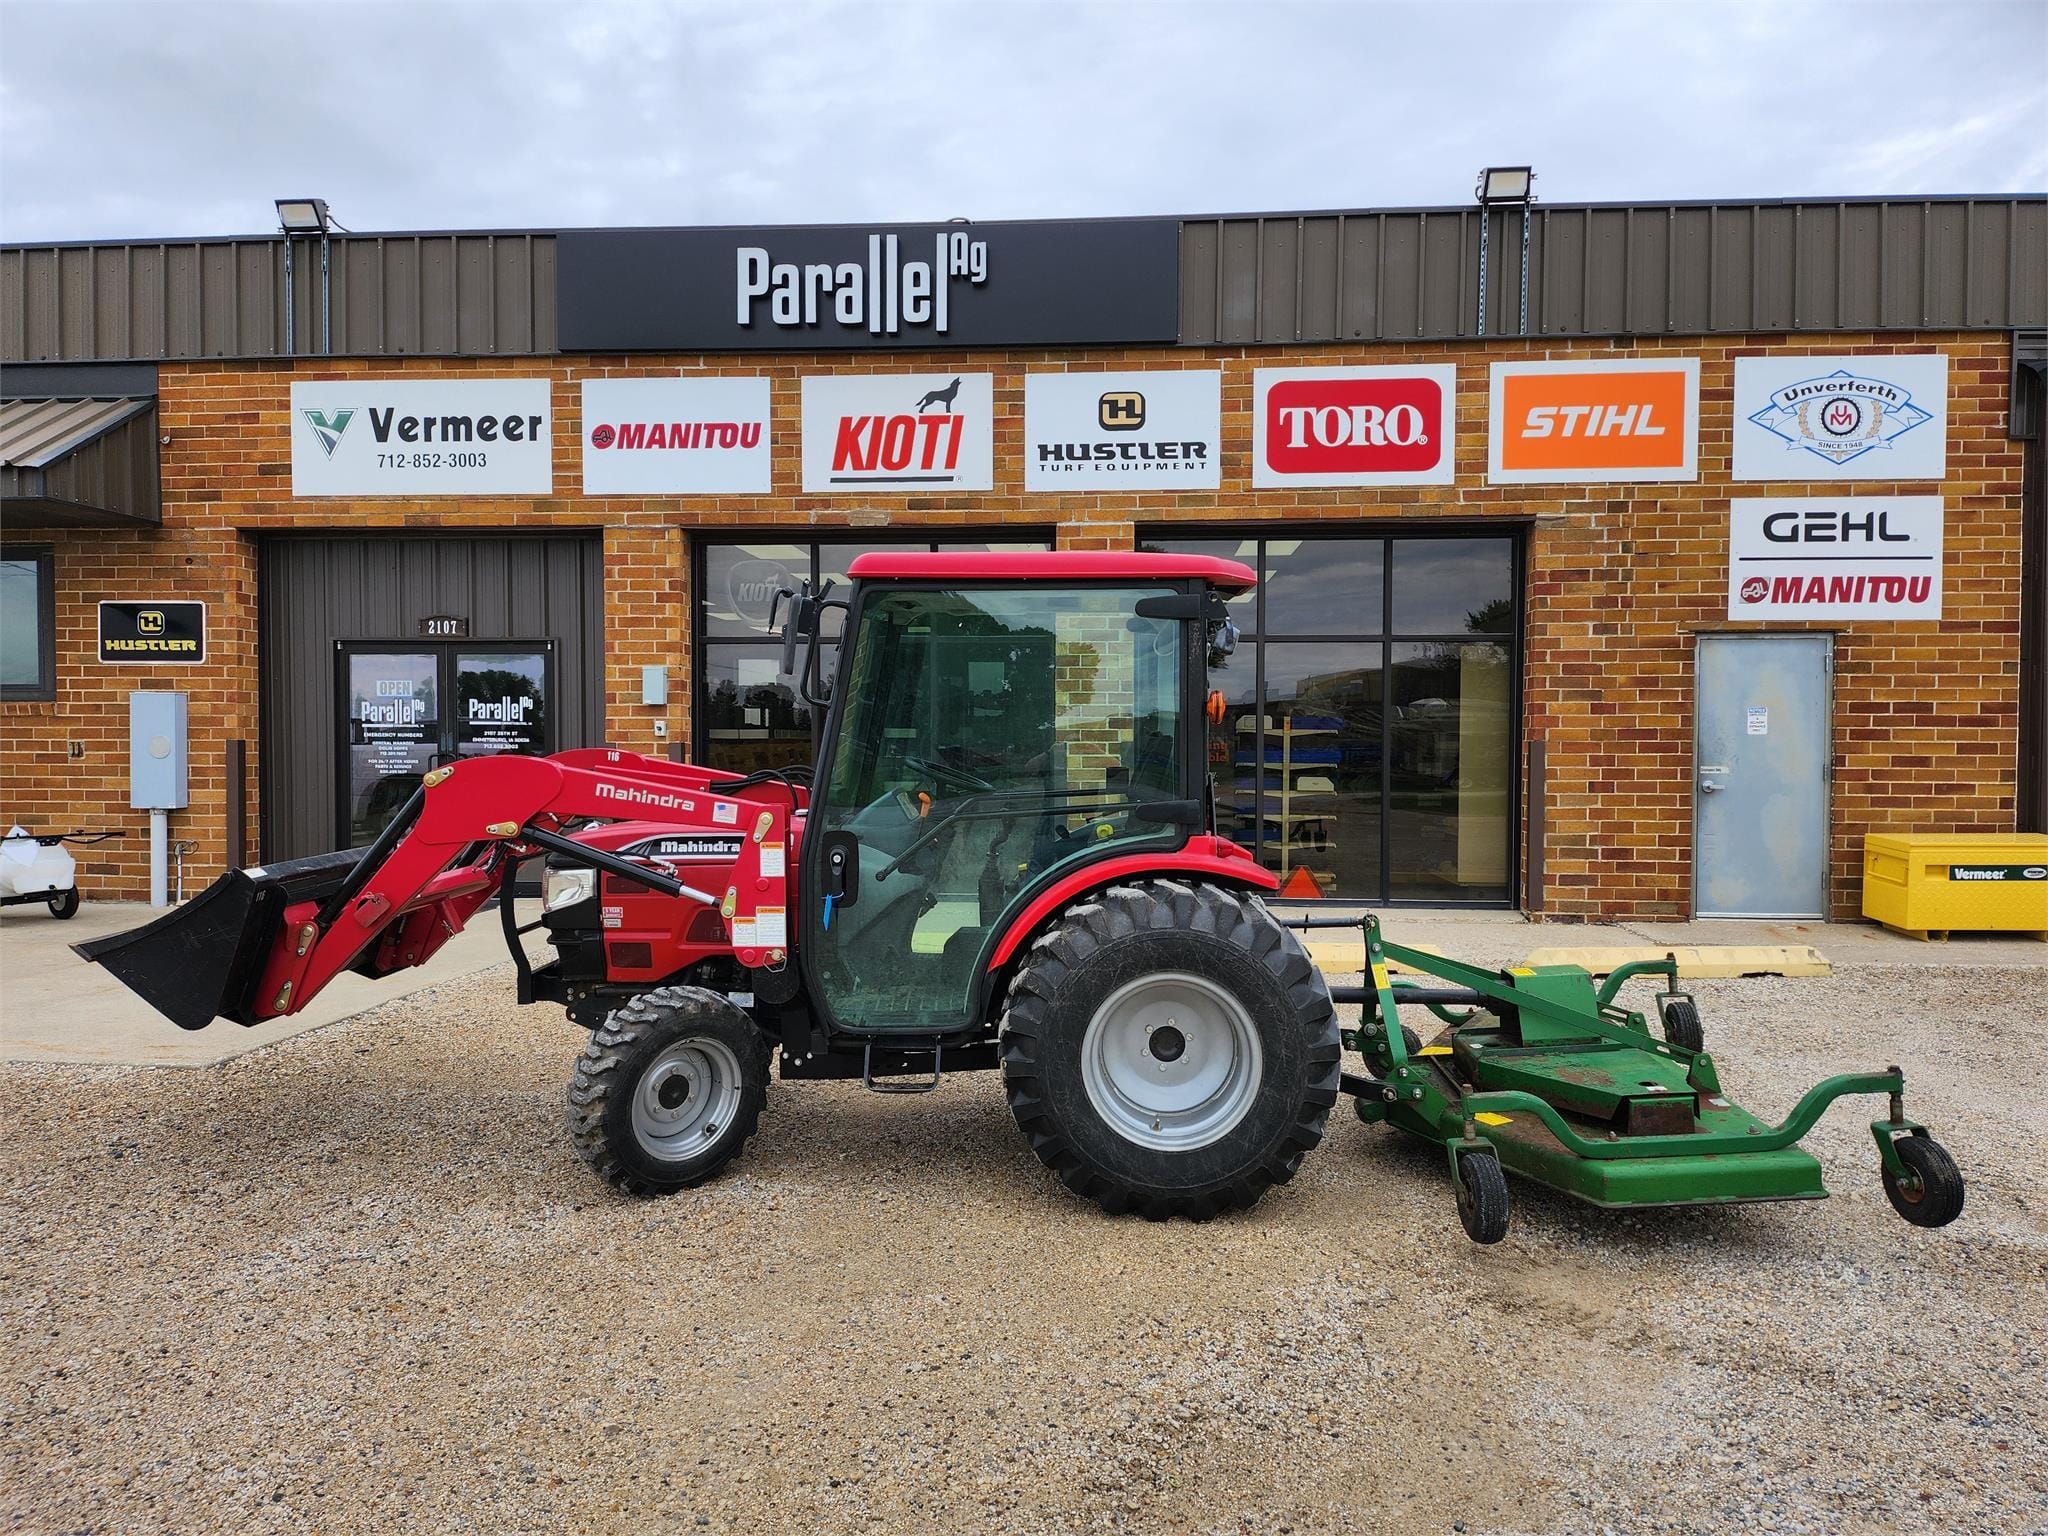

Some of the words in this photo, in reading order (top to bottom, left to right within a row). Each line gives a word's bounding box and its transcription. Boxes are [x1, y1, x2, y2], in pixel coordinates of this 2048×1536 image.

[737, 233, 948, 333] Parallel
[950, 231, 987, 283] Ag
[1784, 380, 1898, 402] Unverferth
[368, 407, 542, 443] Vermeer
[1279, 404, 1425, 448] TORO
[1521, 404, 1666, 439] STIHL
[617, 423, 762, 449] MANITOU
[832, 415, 964, 471] KIOTI
[1817, 441, 1843, 449] SINCE
[1844, 441, 1864, 449] 1948
[377, 453, 487, 469] 712-852-3003
[1037, 441, 1208, 461] HUSTLER
[1039, 463, 1086, 472] TURF
[1095, 461, 1208, 471] EQUIPMENT
[1762, 511, 1911, 542] GEHL
[1771, 575, 1932, 604] MANITOU
[428, 620, 457, 634] 2107
[104, 639, 197, 651] HUSTLER
[379, 681, 411, 695] OPEN
[361, 699, 415, 724] Parallel
[469, 696, 523, 722] Parallel
[607, 751, 620, 762] 116
[595, 783, 695, 812] Mahindra
[660, 840, 741, 853] Mahindra
[1954, 868, 2006, 880] Vermeer
